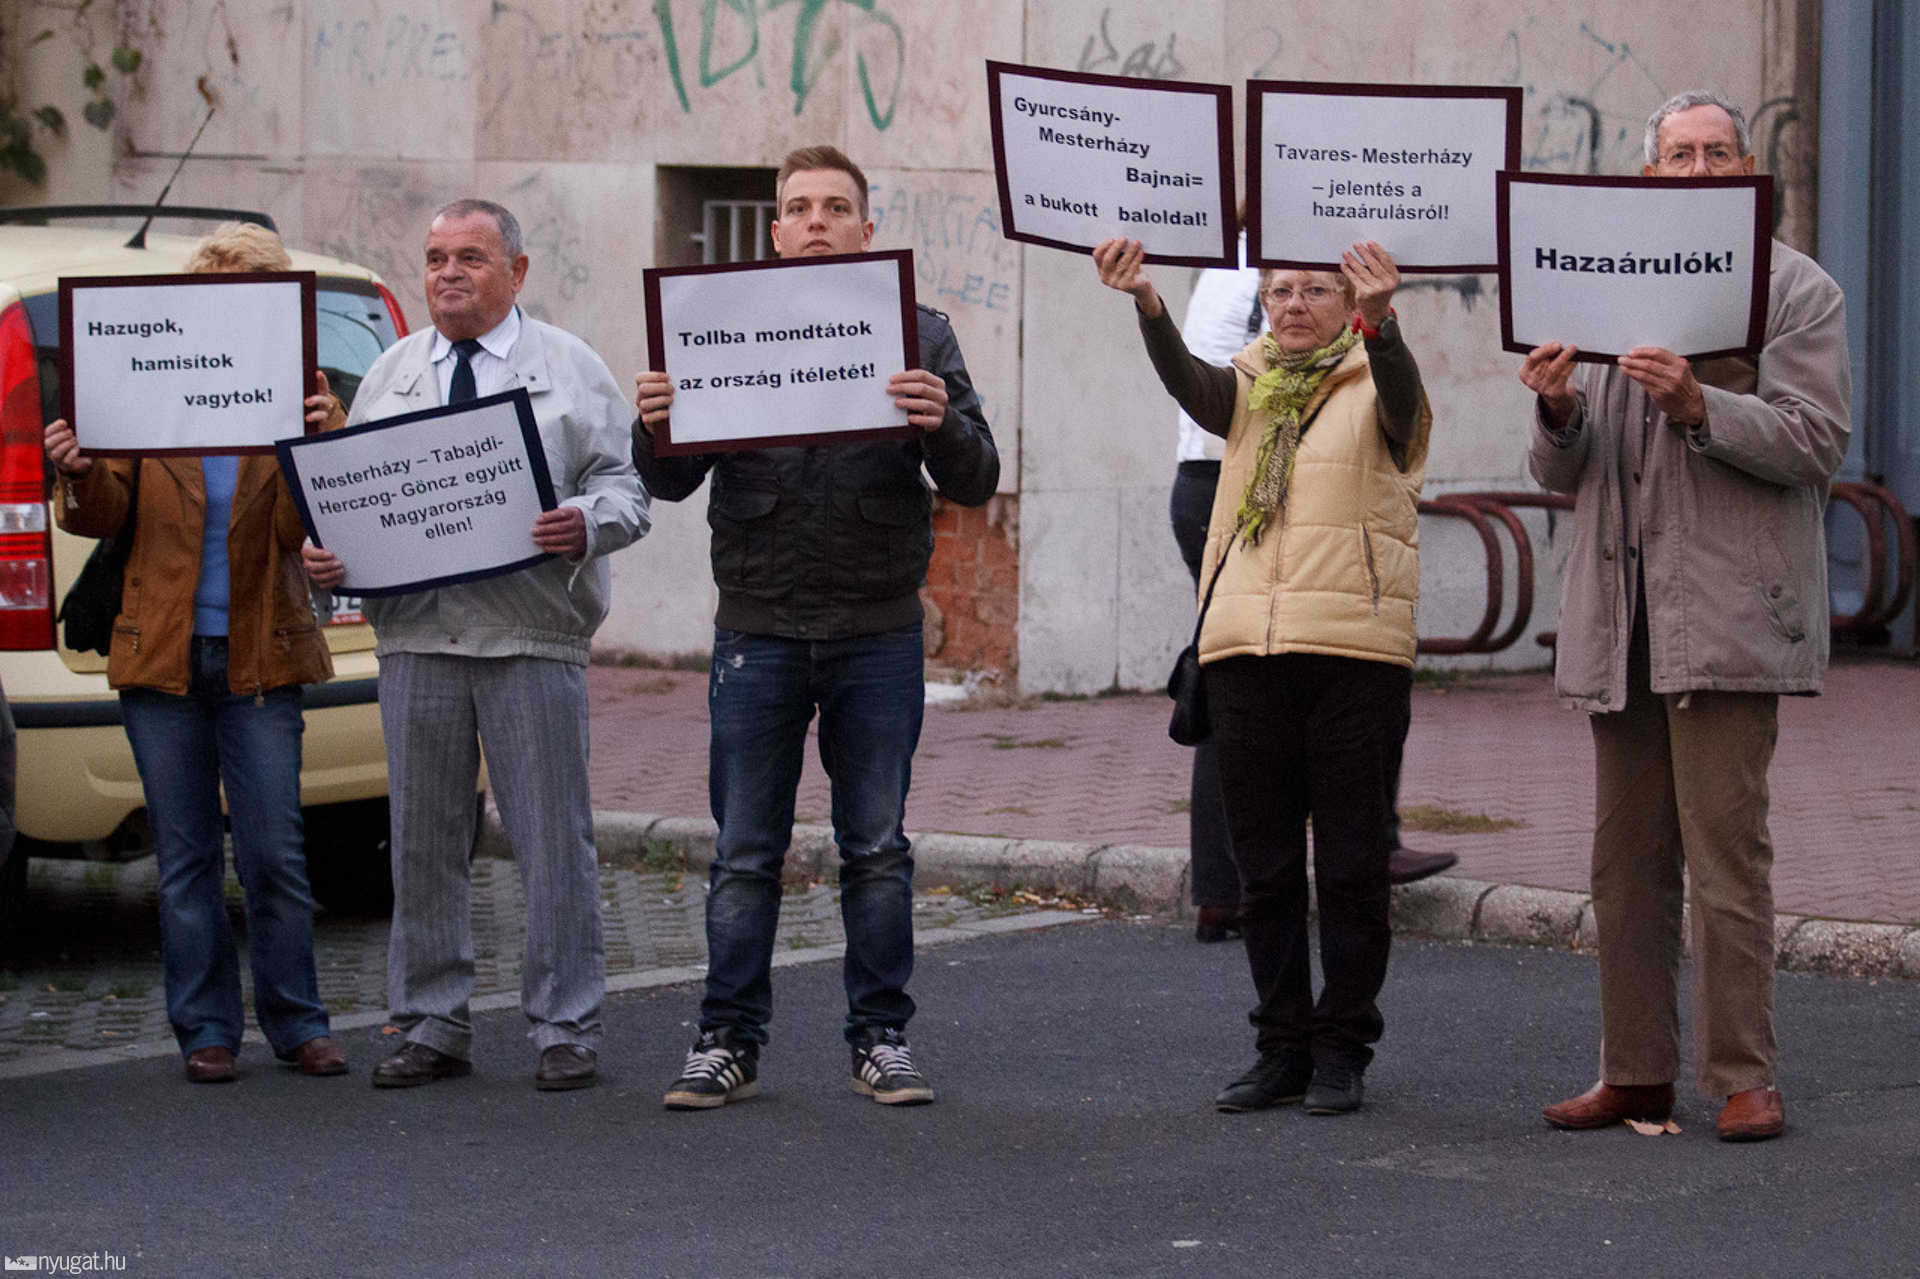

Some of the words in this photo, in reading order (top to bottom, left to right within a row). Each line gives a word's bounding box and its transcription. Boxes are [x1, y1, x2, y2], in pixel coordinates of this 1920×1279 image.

[1014, 96, 1121, 126] Gyurcsány-
[1039, 126, 1150, 159] Mesterházy
[1362, 147, 1473, 168] Mesterházy
[1126, 166, 1203, 189] Bajnai=
[1328, 178, 1405, 199] jelentés
[1411, 184, 1423, 198] a
[1024, 193, 1036, 206] a
[1040, 193, 1099, 218] bukott
[1118, 205, 1208, 227] baloldal!
[1312, 201, 1450, 221] hazaárulásról!
[1535, 247, 1733, 275] Hazaárulók!
[87, 317, 184, 339] Hazugok,
[678, 329, 746, 347] Tollba
[755, 320, 873, 344] mondtátok
[131, 353, 234, 372] hamisítok
[679, 377, 704, 391] az
[710, 368, 782, 389] ország
[789, 362, 876, 385] ítéletét!
[184, 388, 273, 409] vagytok!
[311, 458, 411, 491] Mesterházy
[430, 435, 504, 464] Tabajdi-
[318, 491, 397, 515] Herczog-
[401, 475, 459, 497] Göncz
[465, 456, 523, 484] együtt
[380, 489, 507, 528] Magyarország
[425, 516, 473, 539] ellen!
